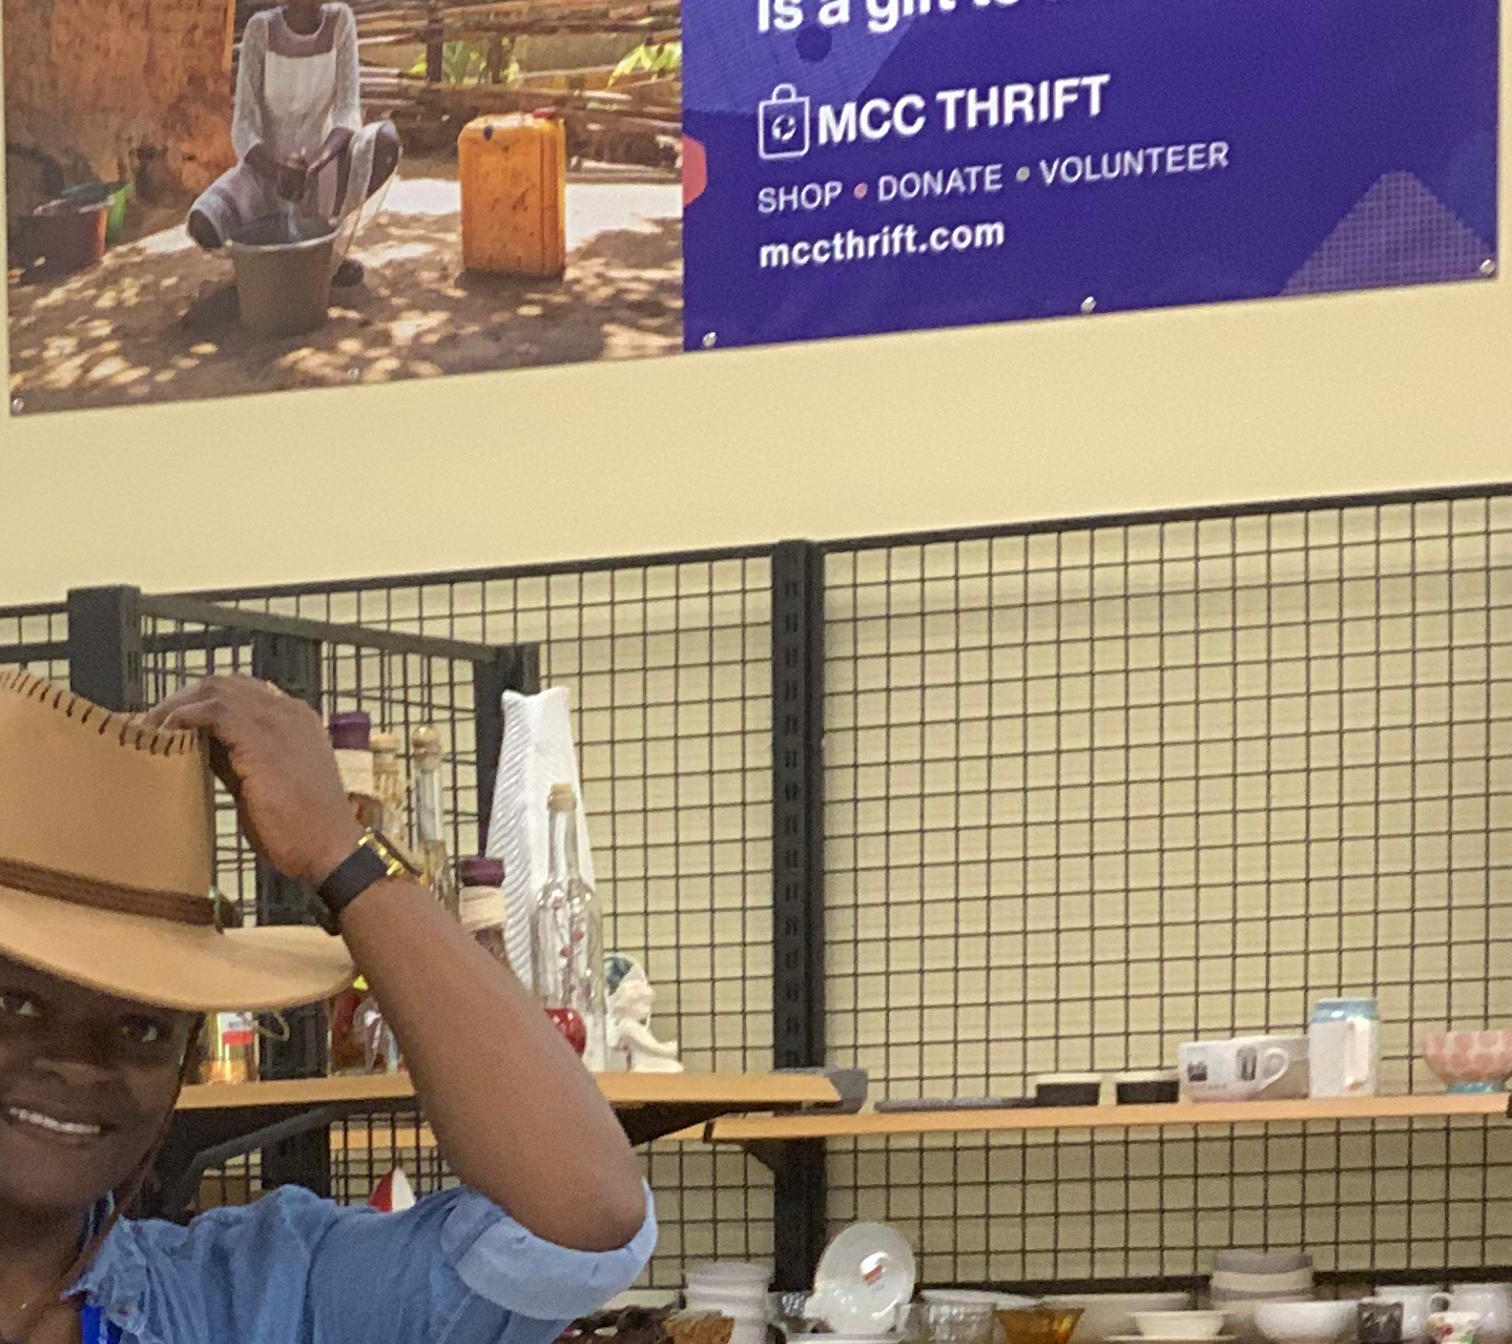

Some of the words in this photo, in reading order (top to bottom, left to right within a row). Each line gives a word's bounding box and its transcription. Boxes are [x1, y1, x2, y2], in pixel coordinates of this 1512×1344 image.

[818, 94, 926, 144] MCC
[936, 74, 1111, 131] THRIFT
[758, 181, 842, 214] SHOP
[878, 165, 1003, 201] DONATE
[1039, 141, 1230, 186] VOLUNTEER
[760, 220, 1006, 269] mccthrift.com
